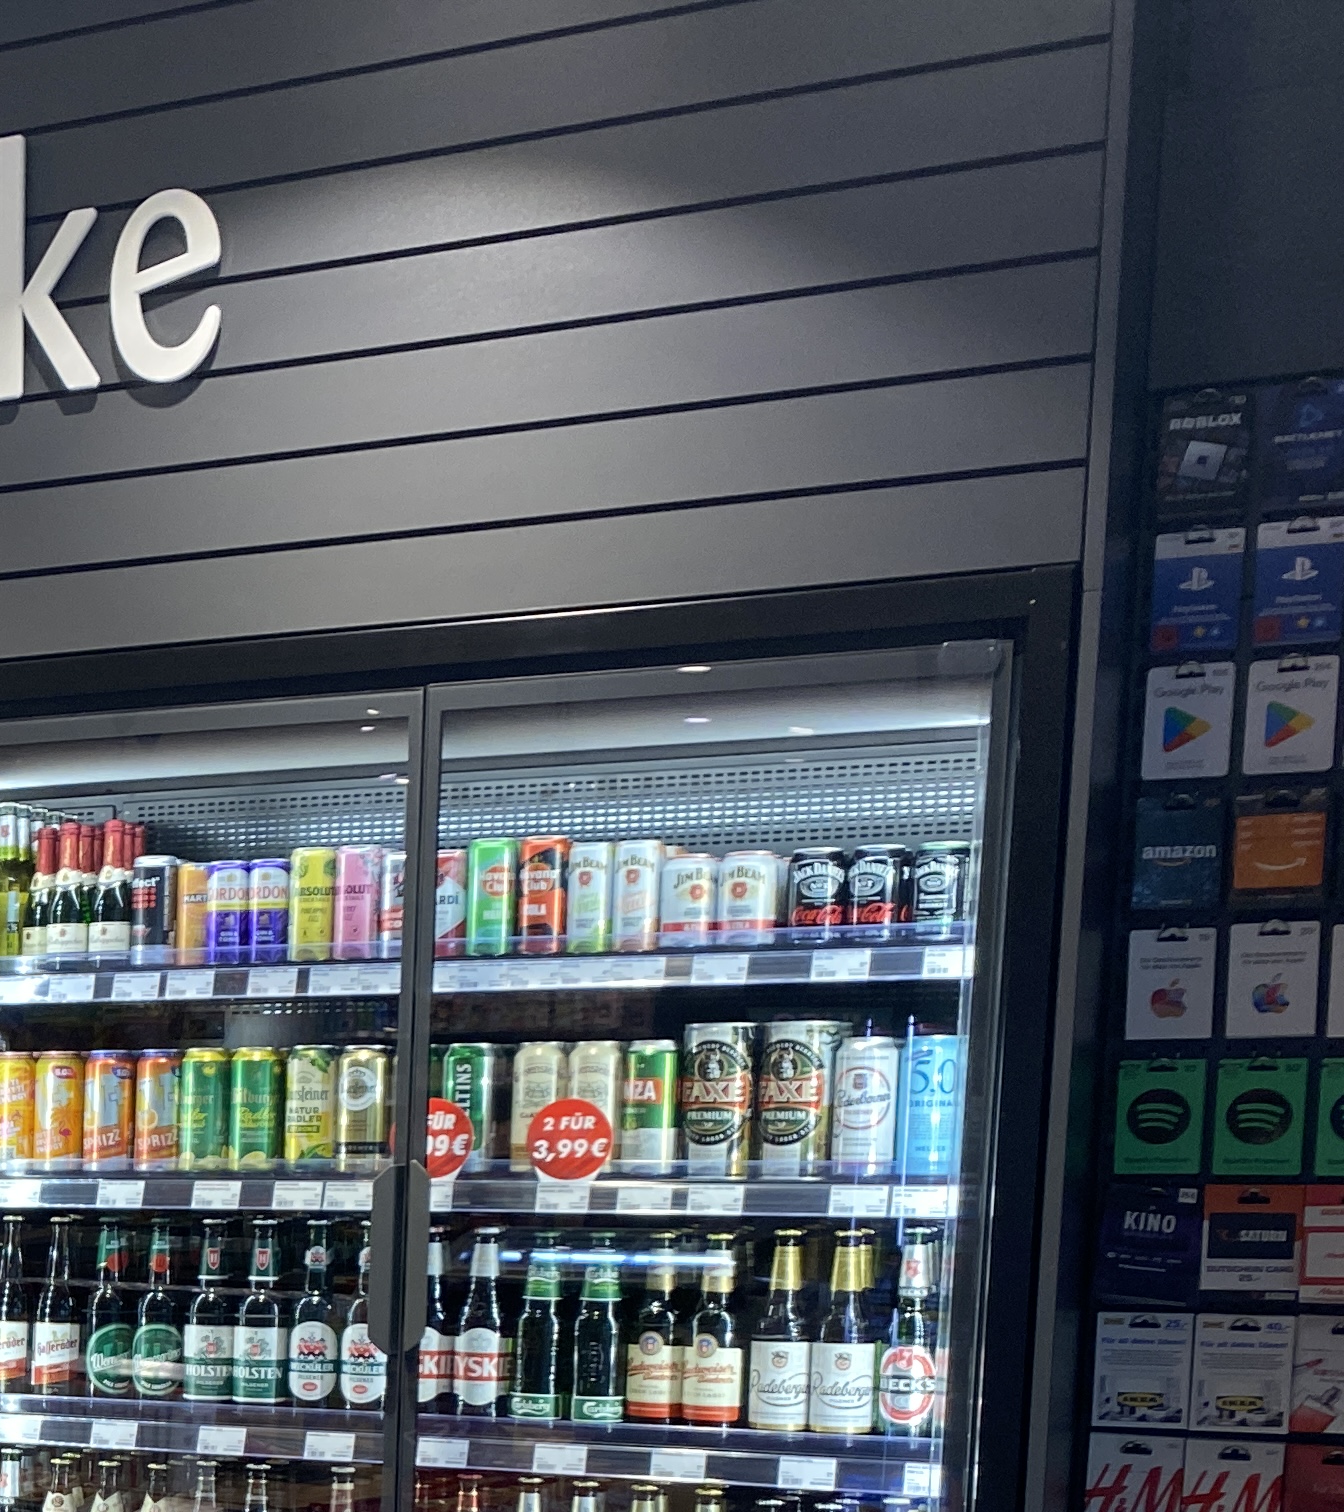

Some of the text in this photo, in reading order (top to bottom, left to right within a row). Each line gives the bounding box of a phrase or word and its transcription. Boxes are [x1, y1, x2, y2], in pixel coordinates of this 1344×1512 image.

[1169, 412, 1242, 431] ROBLOX
[1143, 844, 1216, 859] amazon
[681, 1079, 744, 1102] FAXE
[542, 1112, 595, 1131] 2 FÜR
[686, 1110, 733, 1122] PREMIUM
[533, 1137, 608, 1160] 3,99€
[1123, 1211, 1176, 1234] KINO
[1240, 1230, 1287, 1242] SATURN
[233, 1364, 283, 1379] HOLSTEN
